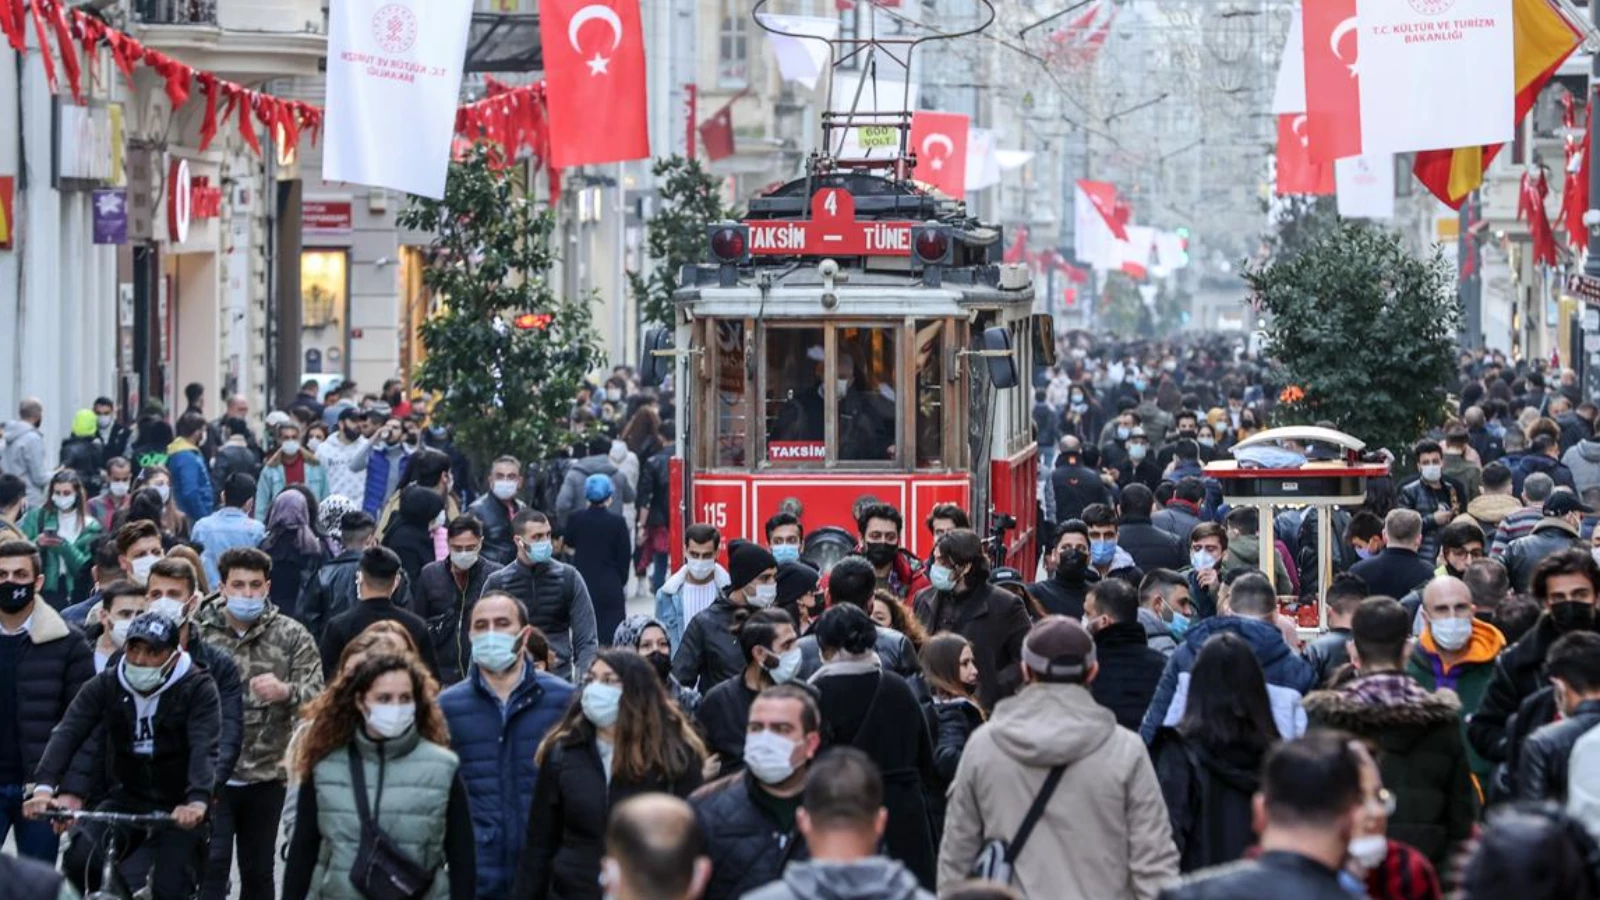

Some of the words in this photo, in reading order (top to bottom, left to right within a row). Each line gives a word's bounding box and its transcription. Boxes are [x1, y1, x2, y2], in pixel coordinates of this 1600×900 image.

[1373, 26, 1390, 35] T.C.
[1393, 22, 1434, 34] KÜLTÜR
[1437, 21, 1450, 31] VE
[1453, 18, 1495, 29] TURİZM
[1404, 31, 1463, 44] BAKANLIĞI
[865, 126, 888, 136] 600
[864, 136, 890, 146] VOLT
[823, 190, 837, 216] 4
[749, 223, 805, 249] TAKSİM
[770, 444, 826, 458] TAKSİM
[703, 501, 727, 528] 115
